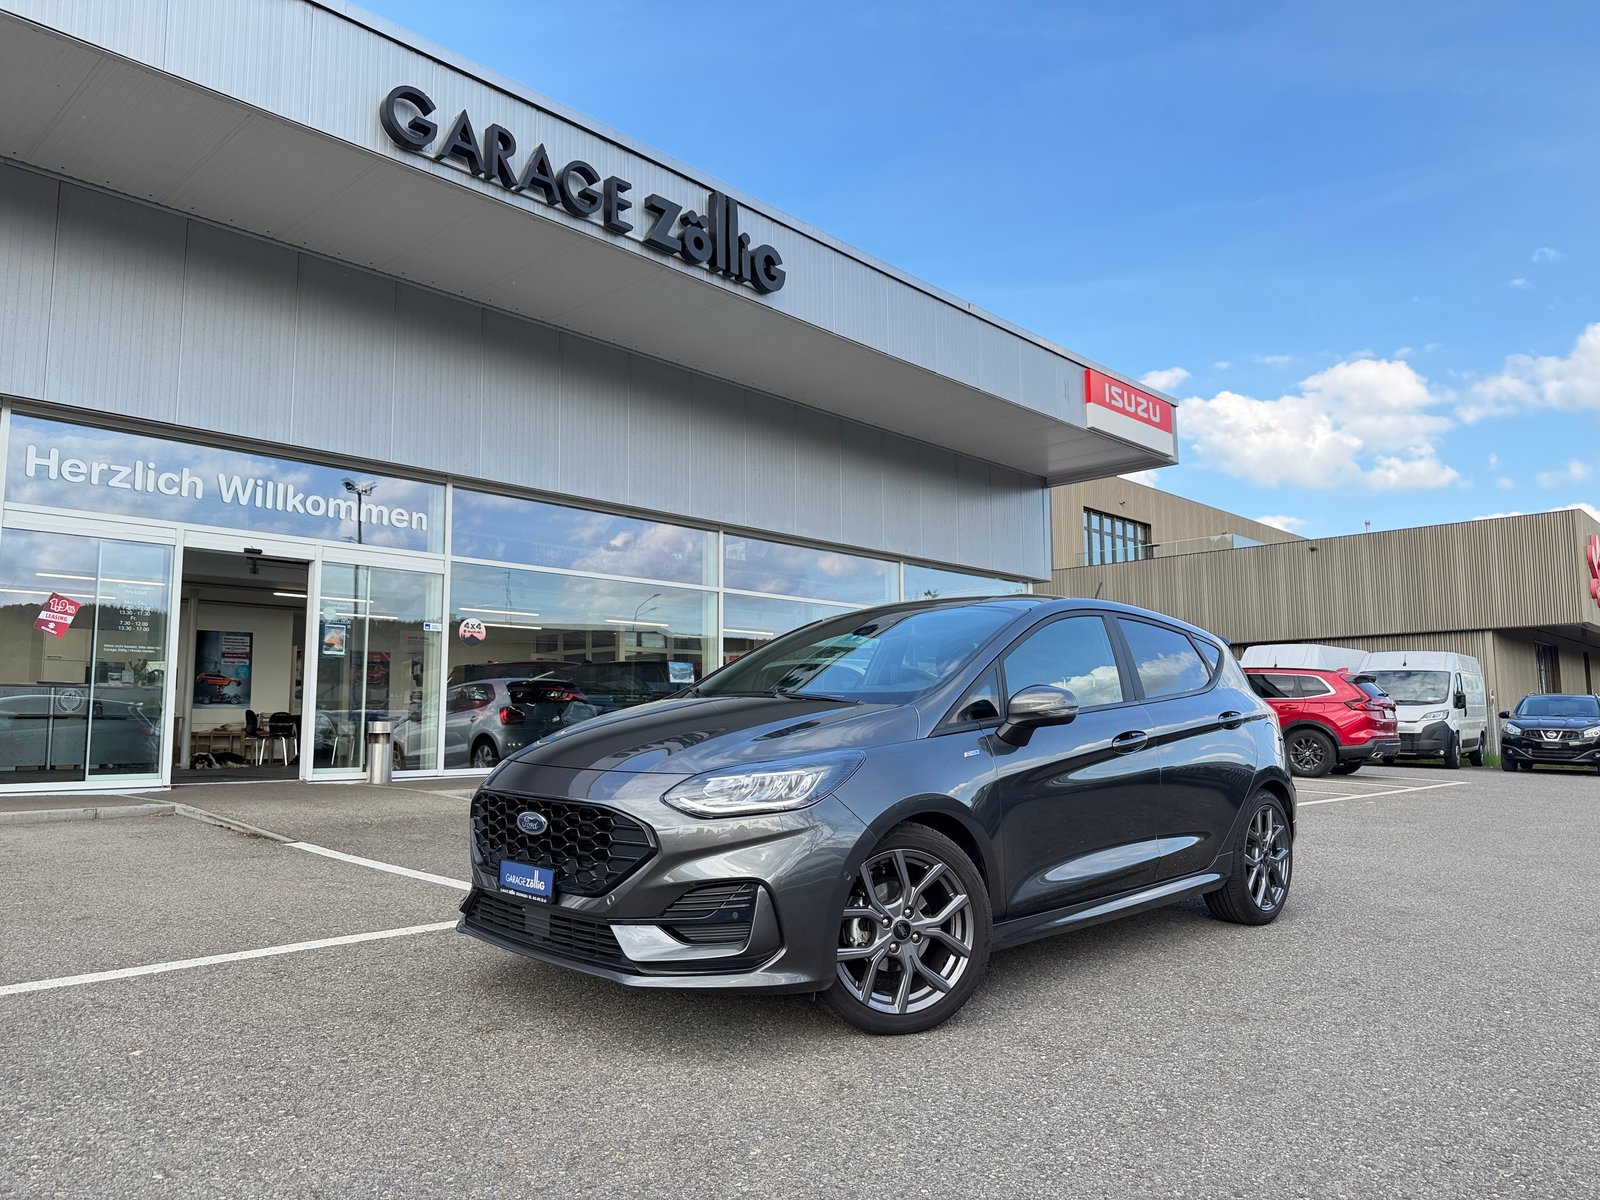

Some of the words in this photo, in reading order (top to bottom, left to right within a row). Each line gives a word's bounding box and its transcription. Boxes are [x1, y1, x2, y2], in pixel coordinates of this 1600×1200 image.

[380, 85, 634, 234] GARAGE
[1104, 382, 1160, 423] ISUZU
[25, 444, 204, 499] Herzlich
[217, 473, 428, 531] Willkommen
[45, 612, 68, 621] LEASING
[464, 622, 481, 630] 4x4
[522, 816, 538, 829] Ford
